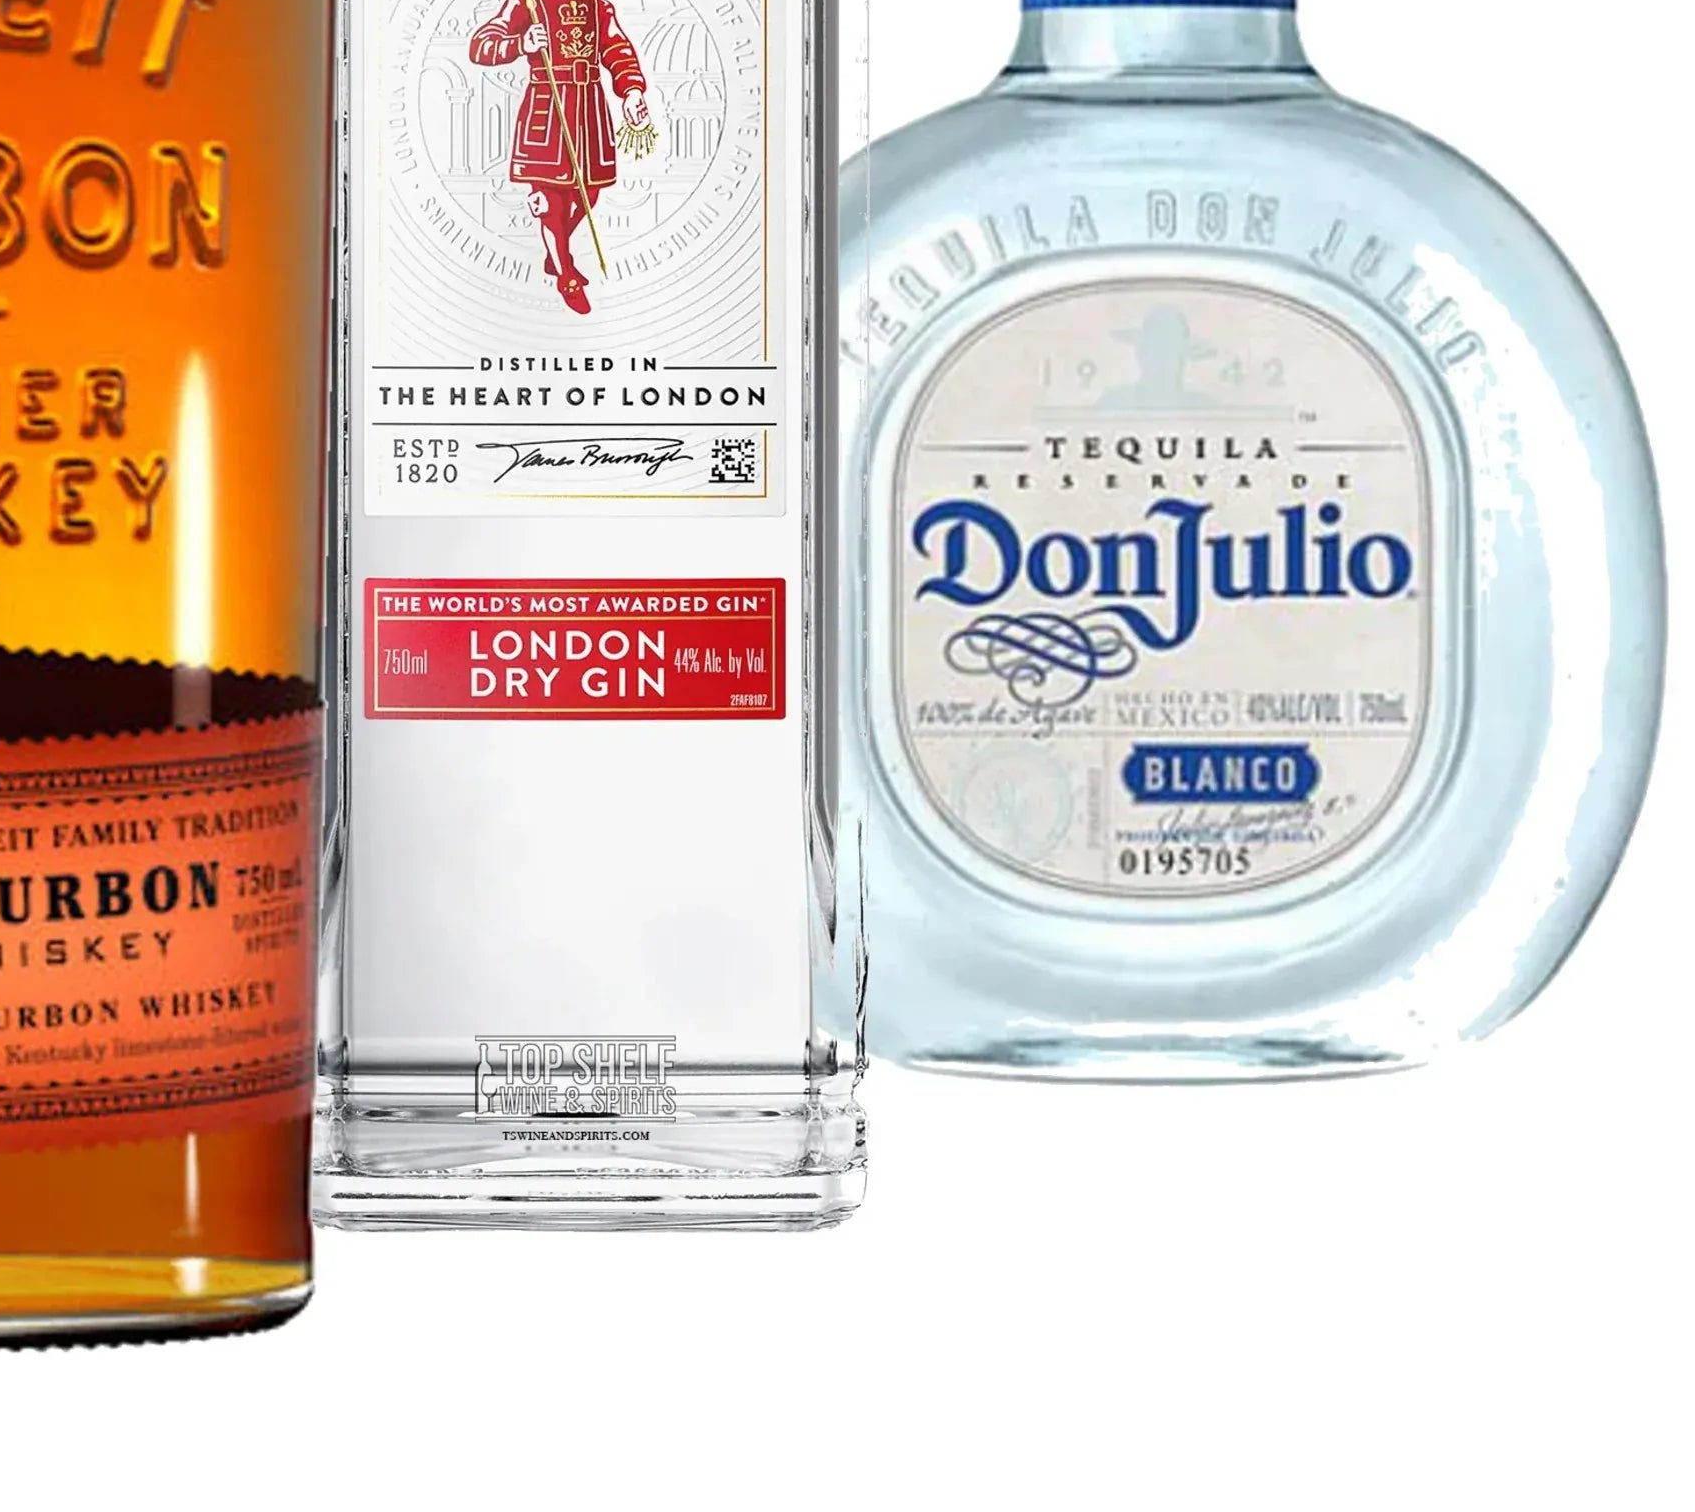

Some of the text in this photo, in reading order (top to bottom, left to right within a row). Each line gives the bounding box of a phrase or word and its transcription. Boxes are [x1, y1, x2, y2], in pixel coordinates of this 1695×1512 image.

[1146, 189, 1280, 245] DON
[479, 357, 659, 372] DISTILLED IN
[378, 386, 767, 406] THE HEART OF LONDON
[1045, 437, 1280, 462] TEQUILA
[395, 463, 459, 484] 1820
[382, 596, 423, 613] THE
[528, 596, 590, 613] MOST
[595, 596, 710, 613] AWARDED
[469, 629, 667, 661] LONDON
[383, 648, 429, 676] 750ml
[673, 647, 768, 679] 44% Alc. by Vol.
[469, 666, 667, 699] DRY GIN
[1144, 756, 1298, 793] BLANCO
[52, 817, 163, 850] FAMILY
[173, 800, 300, 840] TRADITION
[1118, 846, 1252, 876] 0195705
[234, 863, 275, 898] 750
[139, 981, 278, 1021] WHISKEY
